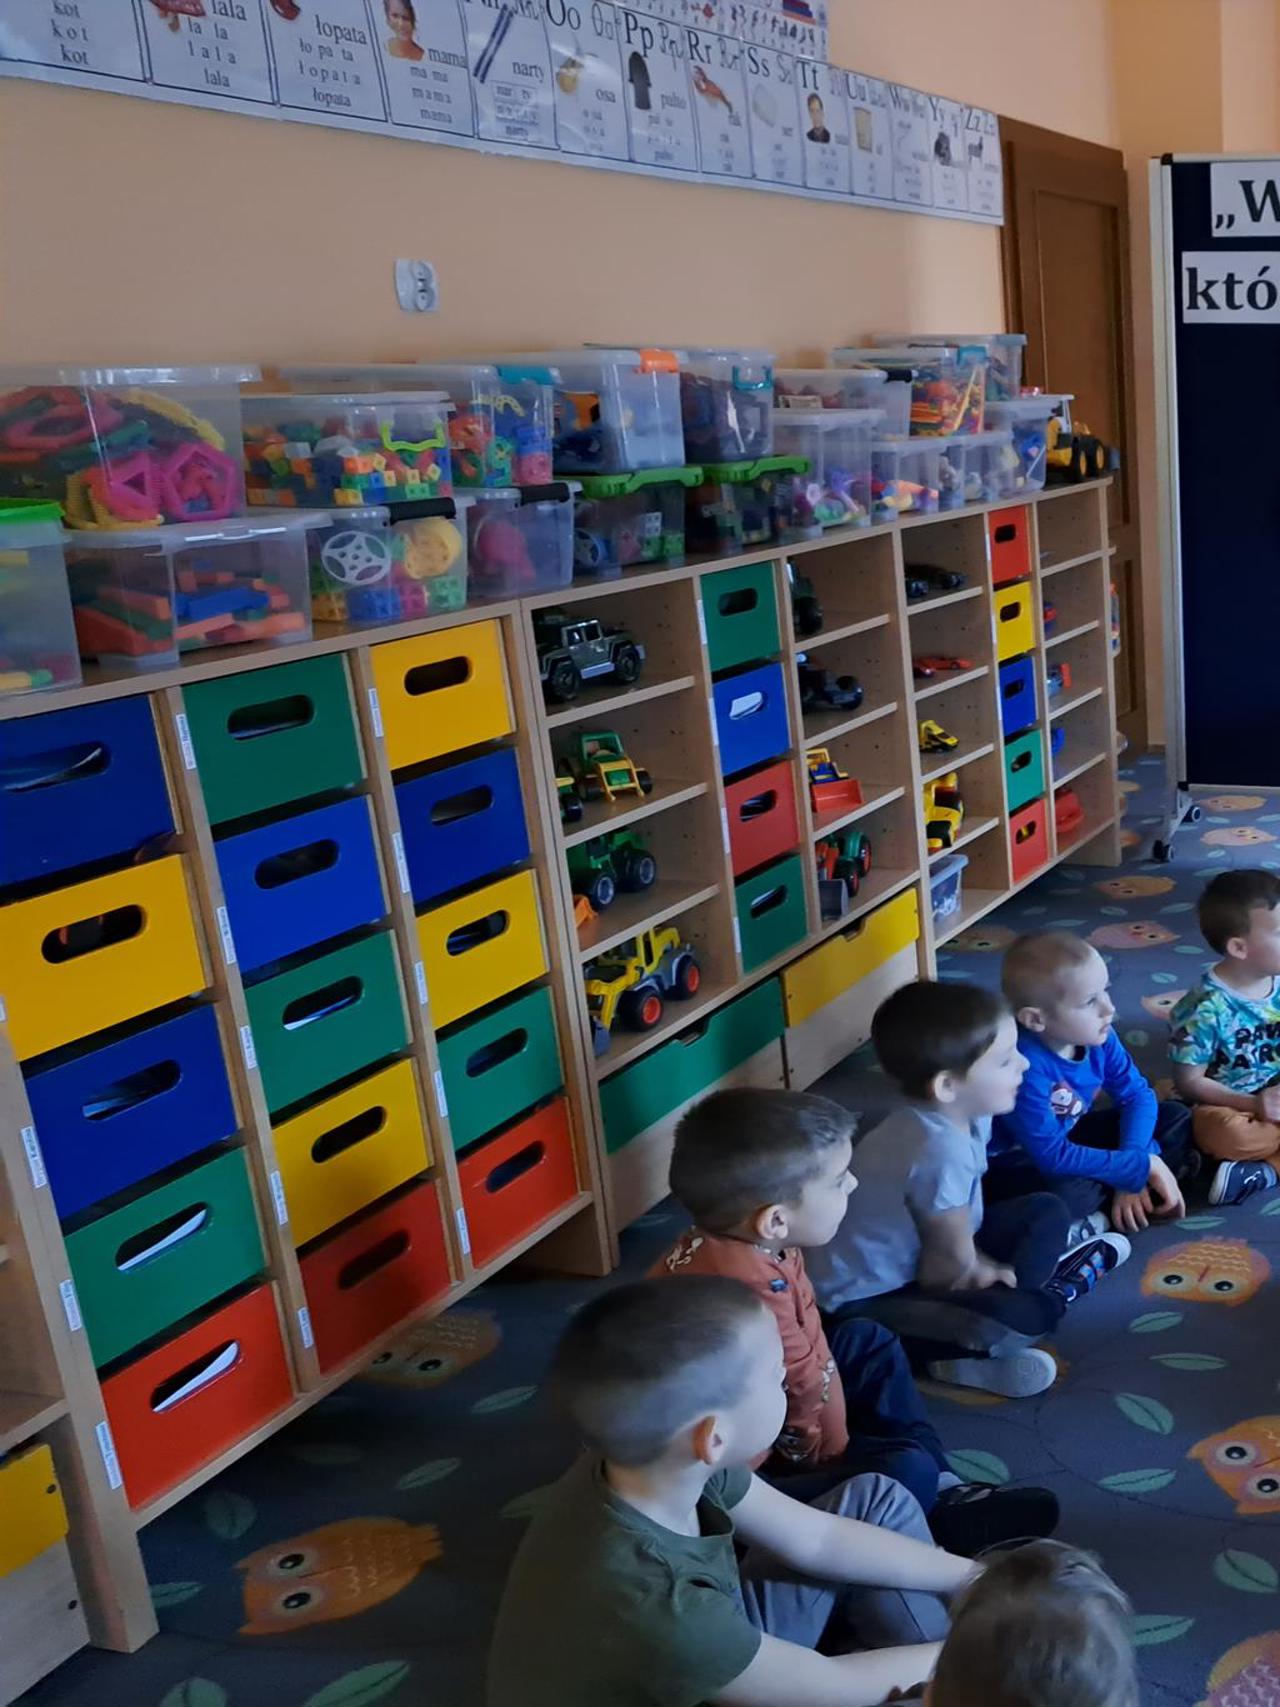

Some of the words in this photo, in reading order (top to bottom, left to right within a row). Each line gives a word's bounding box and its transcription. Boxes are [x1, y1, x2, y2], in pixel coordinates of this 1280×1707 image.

[624, 11, 655, 58] Pp
[687, 30, 712, 64] Rr
[60, 44, 89, 65] kot
[748, 46, 770, 78] Ss
[204, 67, 231, 88] lala
[796, 59, 819, 91] Tt
